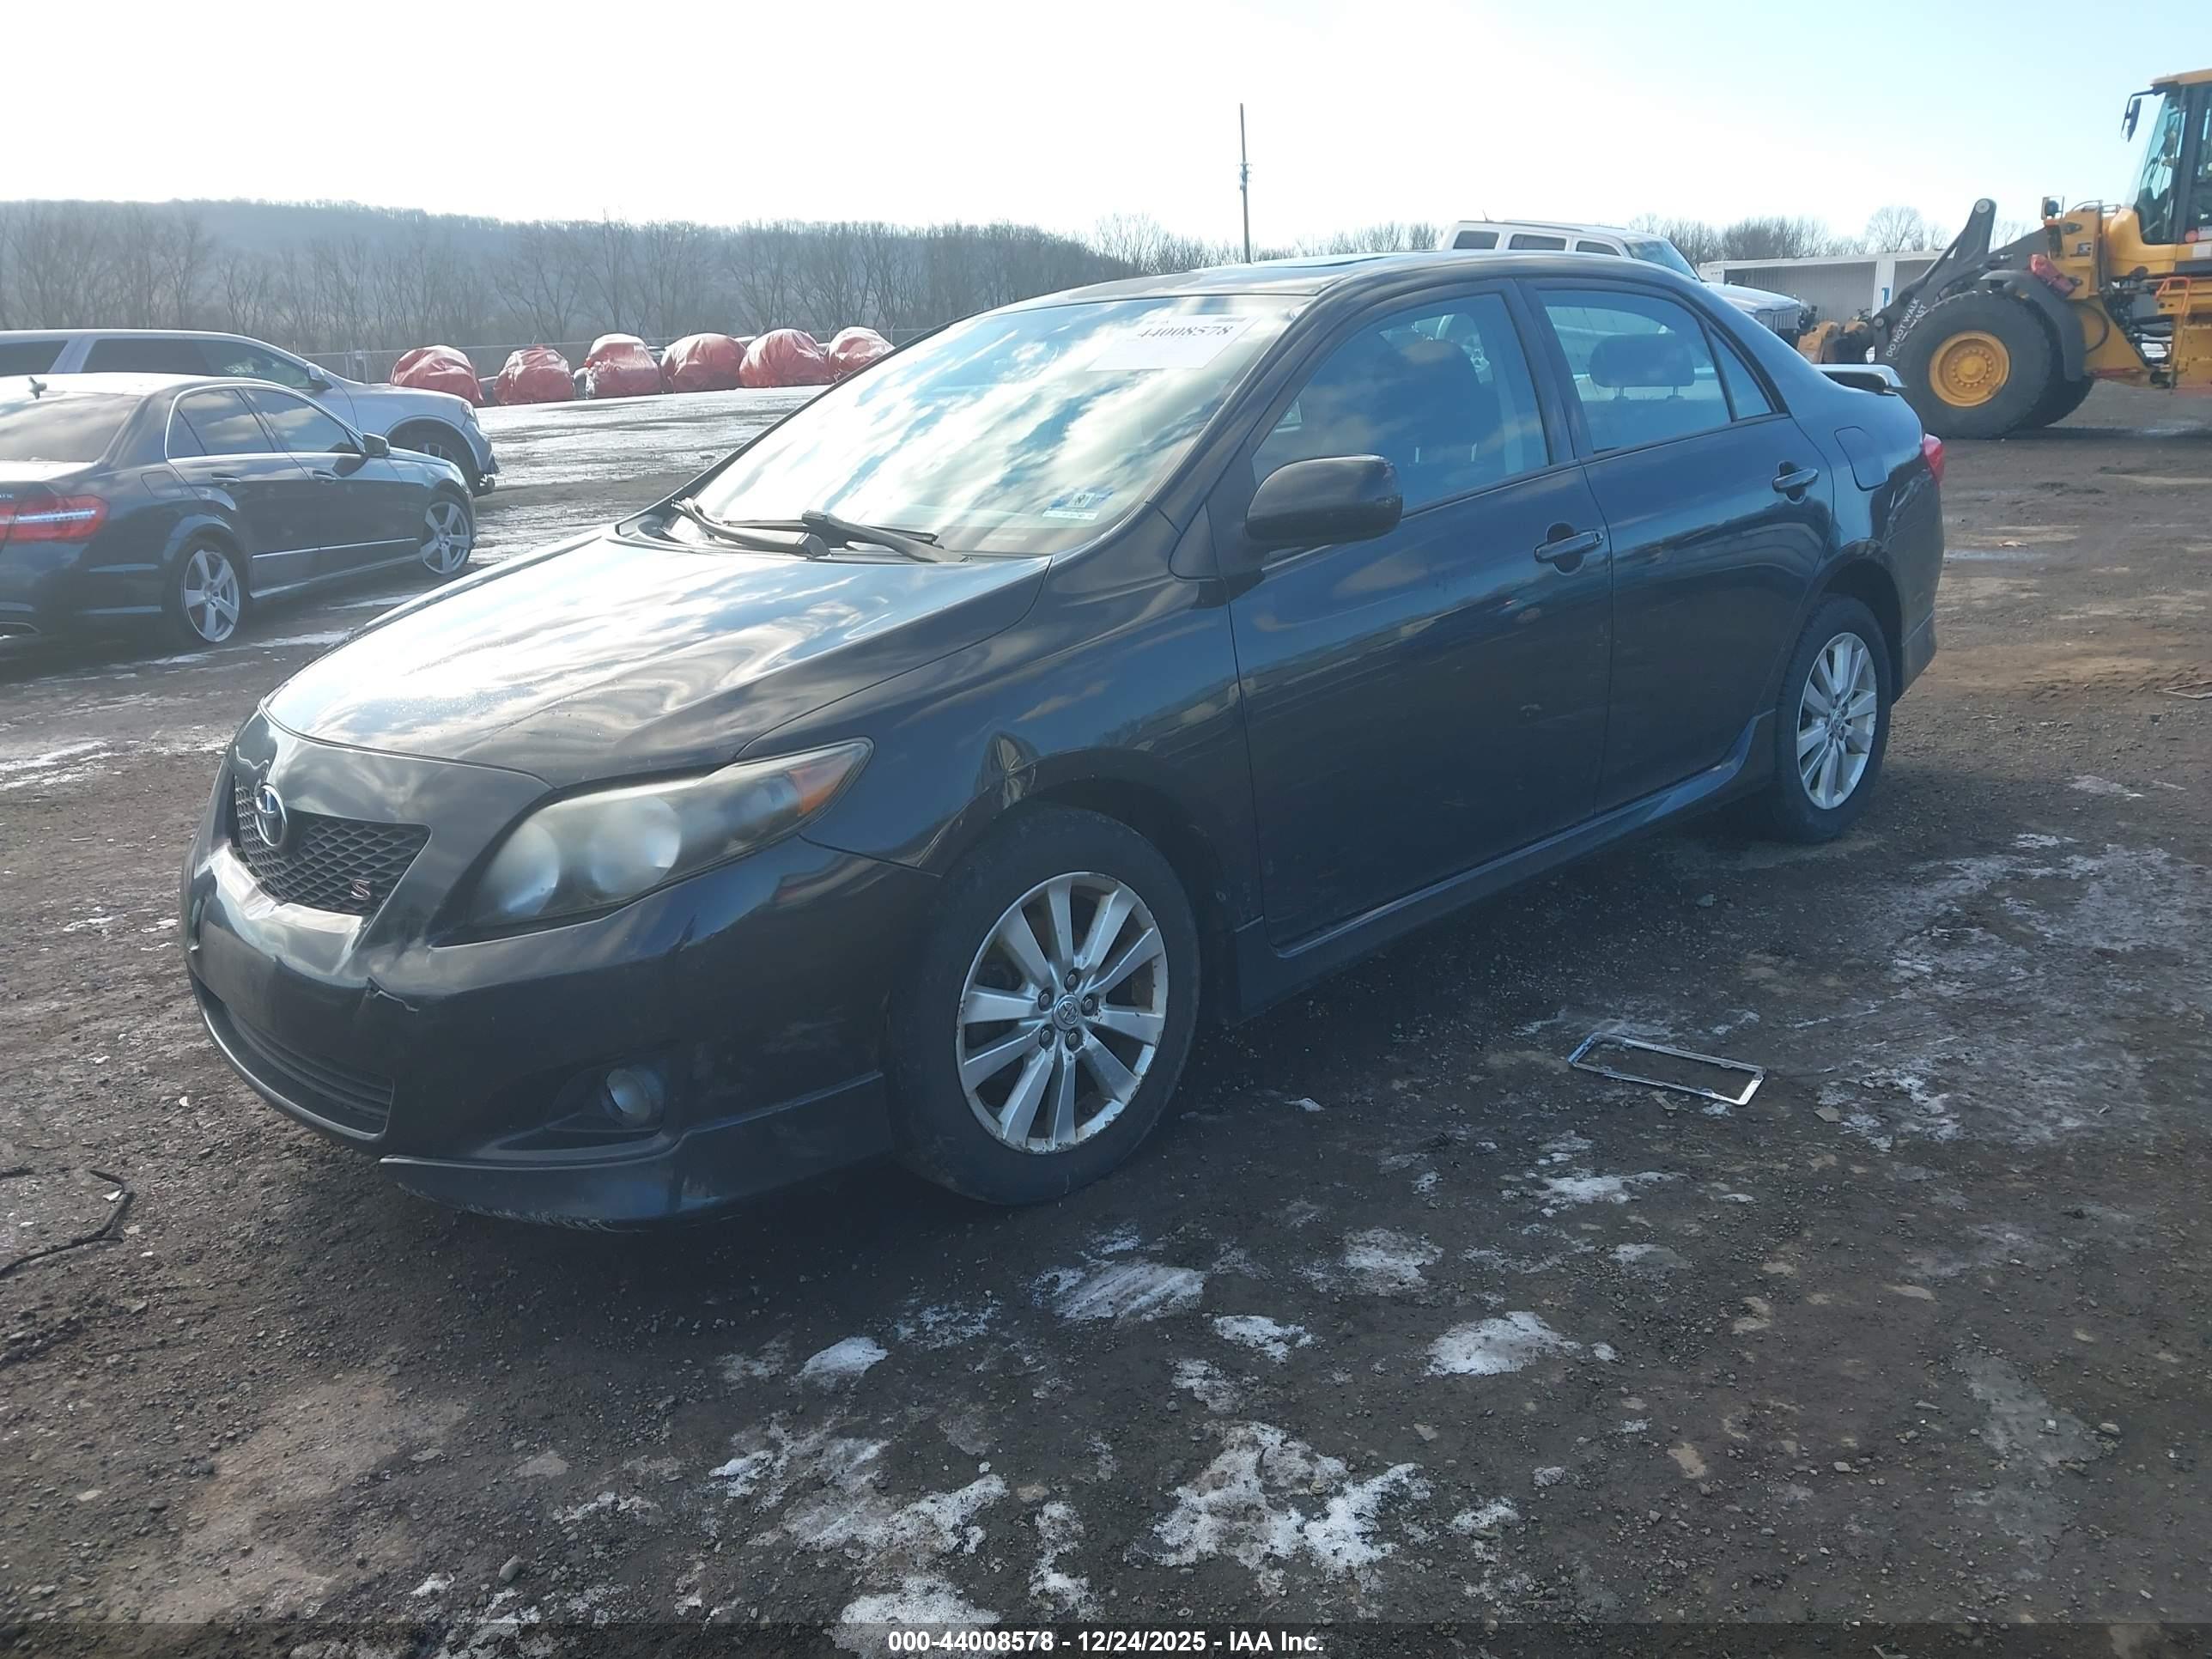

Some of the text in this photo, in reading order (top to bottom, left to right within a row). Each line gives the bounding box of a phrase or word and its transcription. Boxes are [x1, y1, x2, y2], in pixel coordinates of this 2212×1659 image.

[1138, 325, 1234, 337] 44008578
[1886, 297, 1920, 357] DO NOT WALK
[350, 878, 371, 901] S
